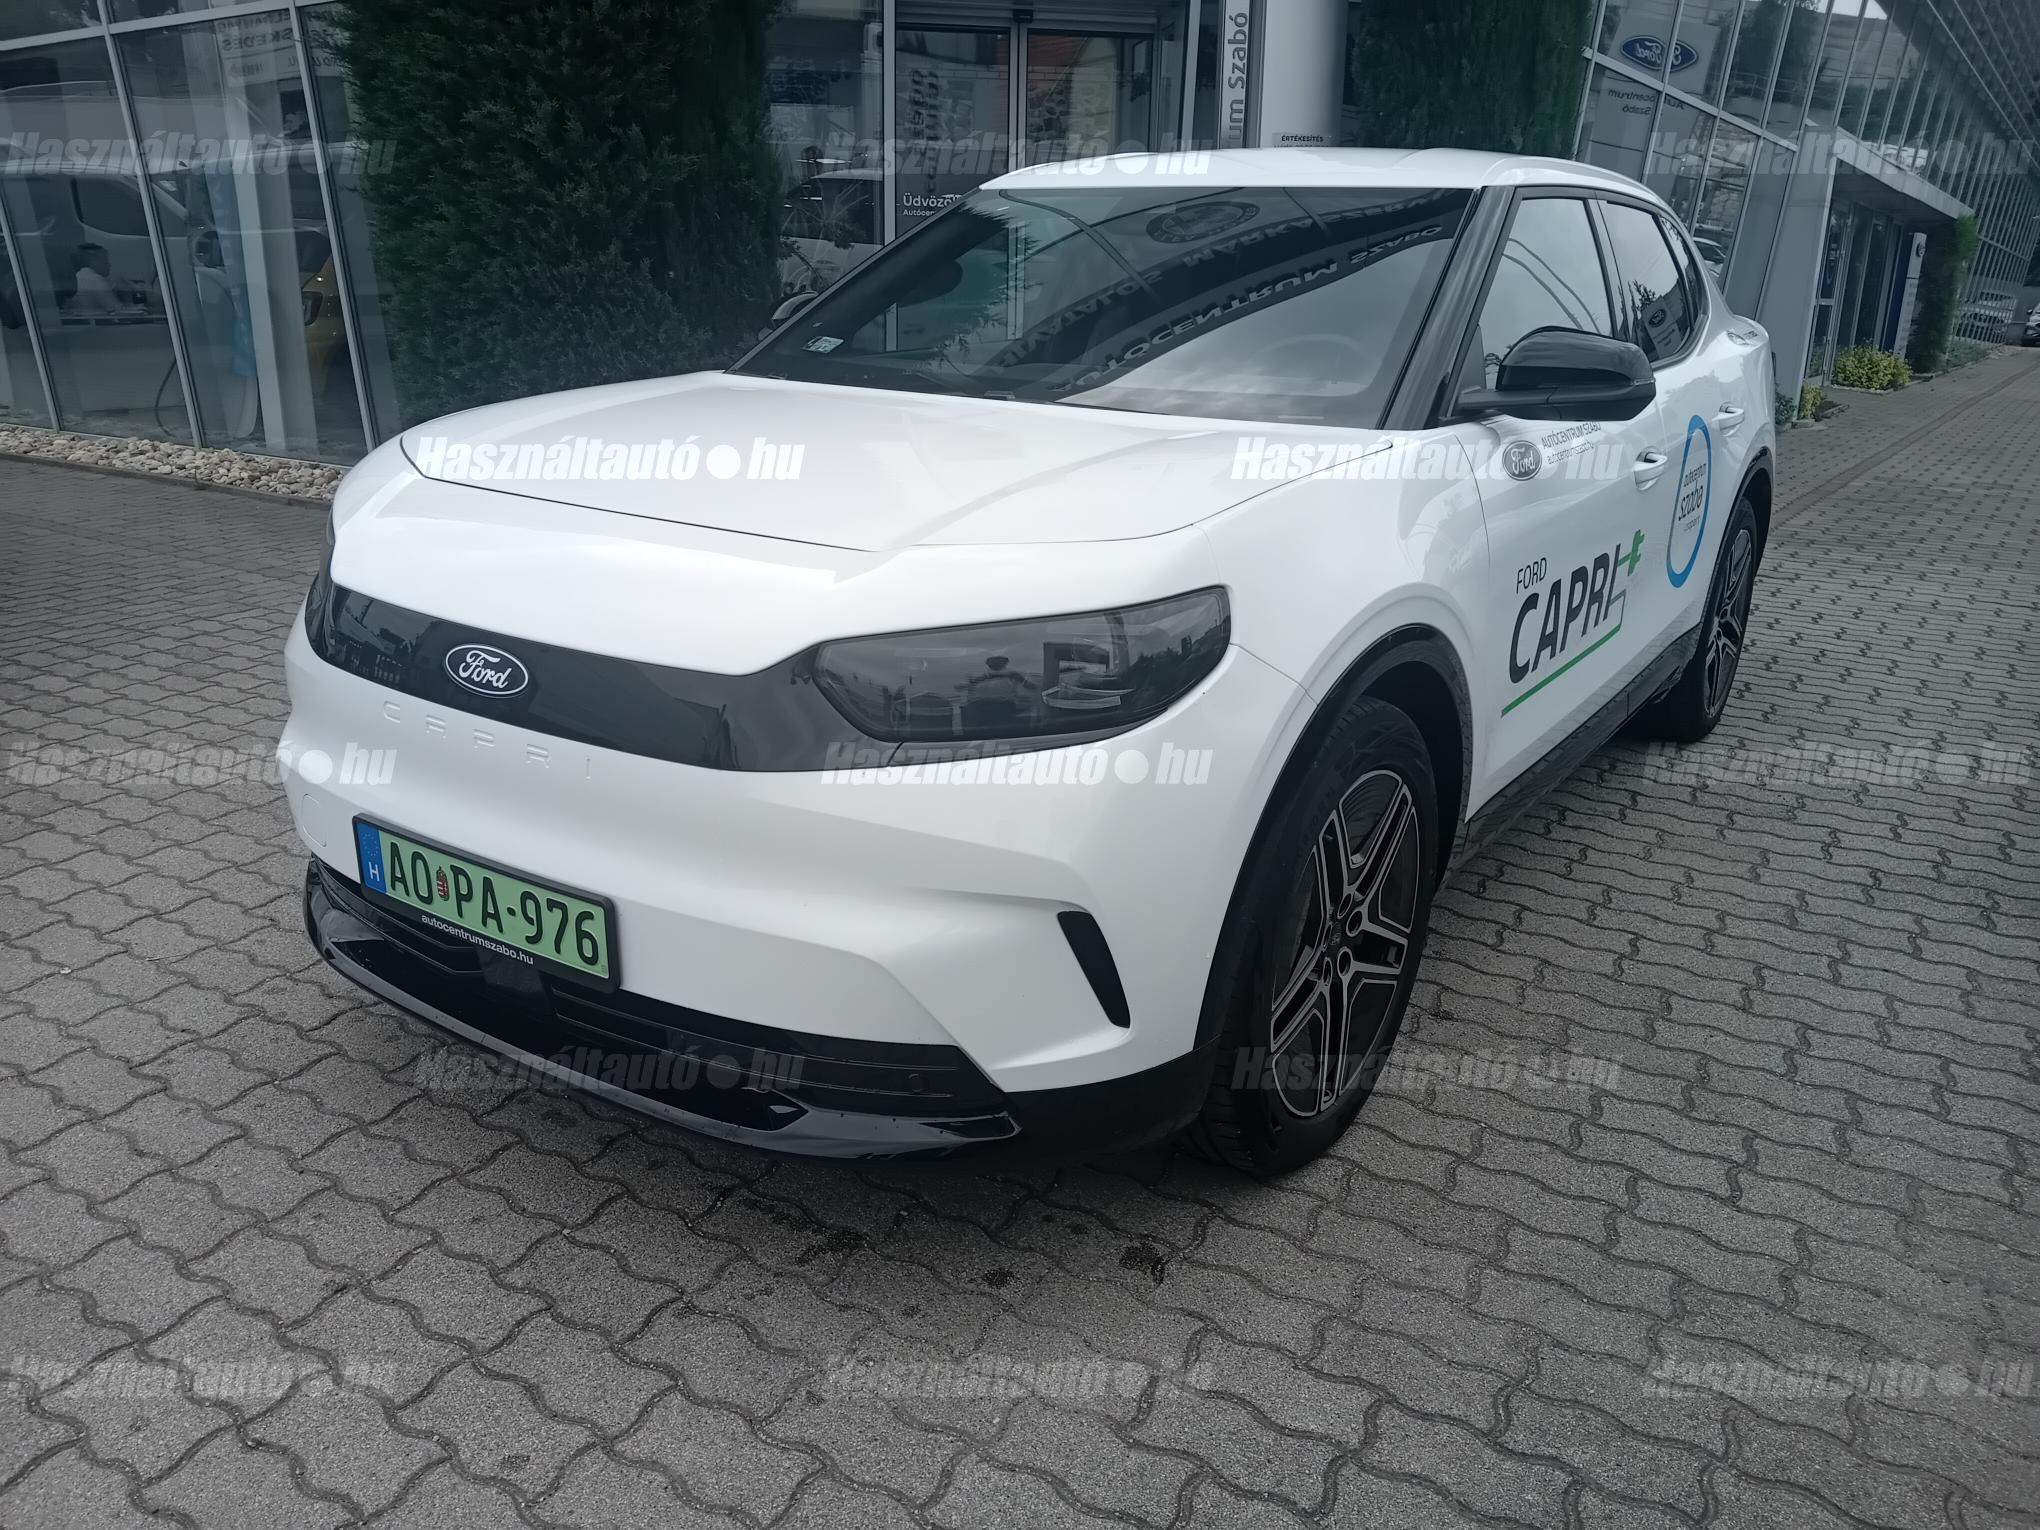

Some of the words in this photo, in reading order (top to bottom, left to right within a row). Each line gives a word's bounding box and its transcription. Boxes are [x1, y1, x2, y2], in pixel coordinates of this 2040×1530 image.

[1228, 12, 1249, 89] Szabó
[1510, 447, 1536, 475] Ford
[1516, 557, 1548, 595] FORD
[1509, 543, 1622, 684] CAPRI
[458, 649, 513, 690] Ford
[368, 862, 380, 882] H
[421, 913, 534, 966] autocentrumszabo.hu
